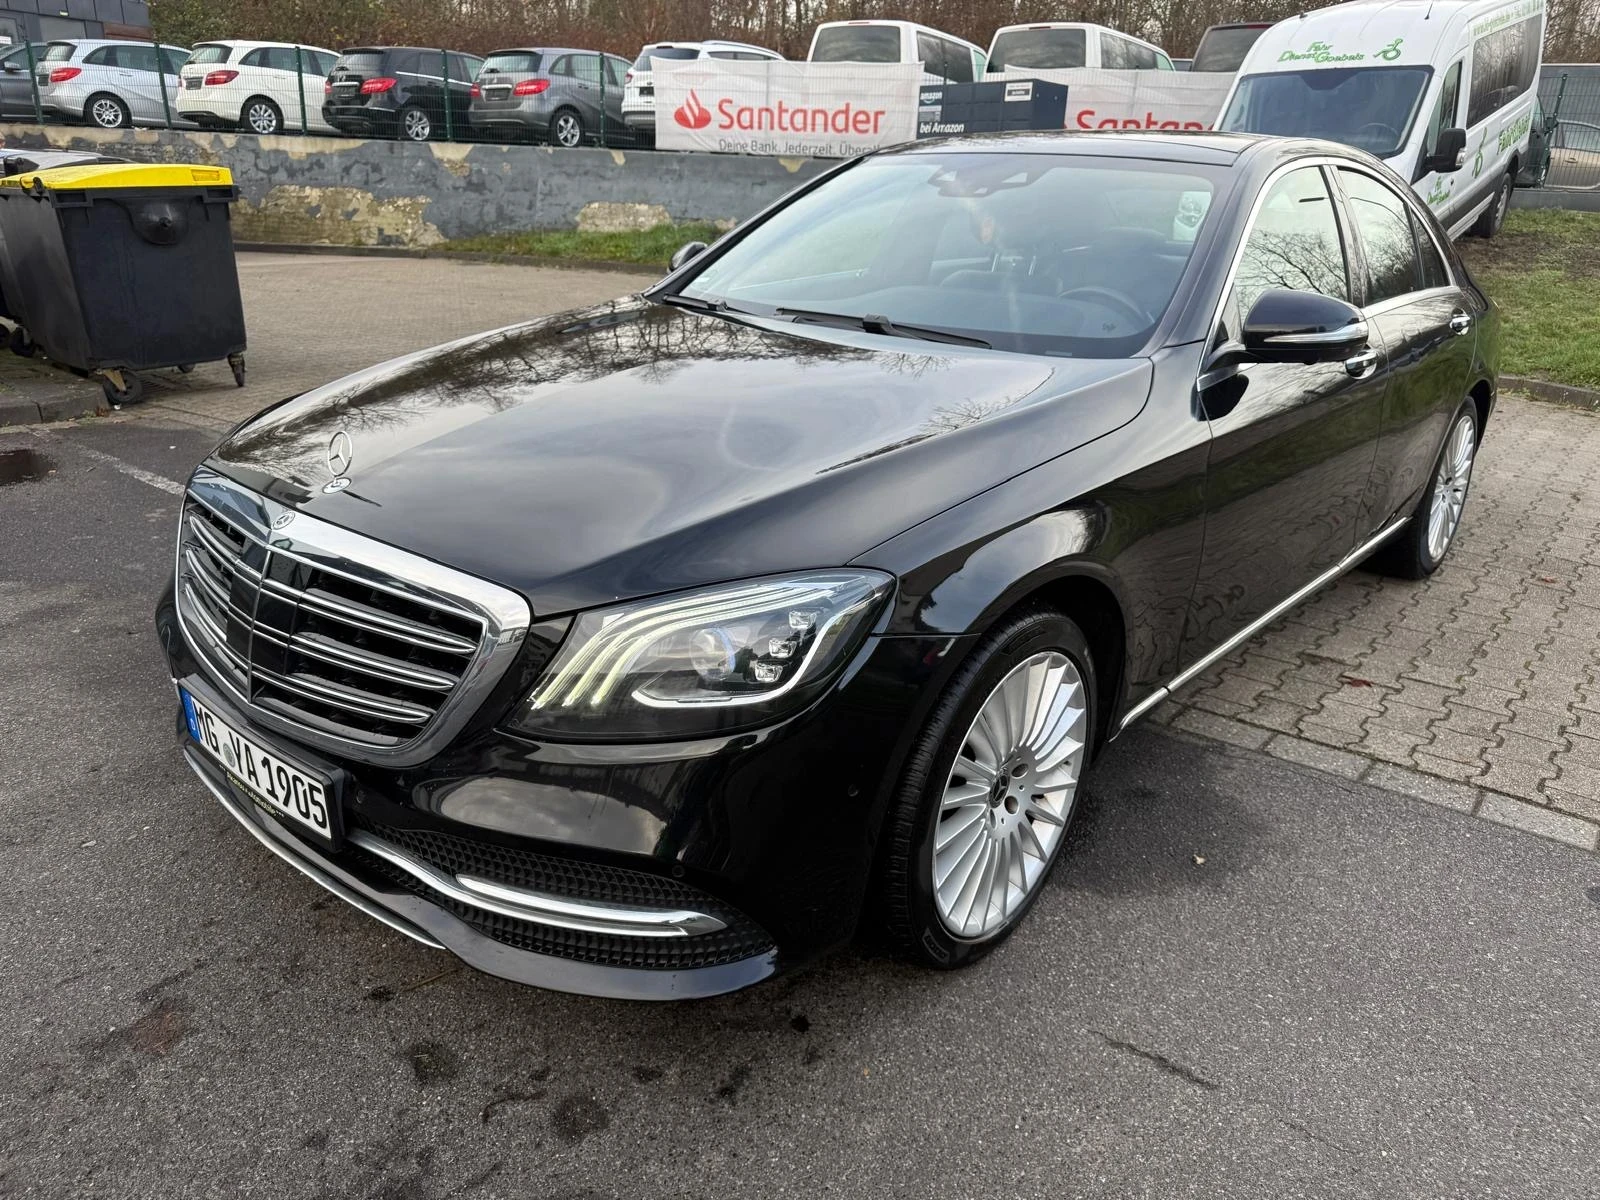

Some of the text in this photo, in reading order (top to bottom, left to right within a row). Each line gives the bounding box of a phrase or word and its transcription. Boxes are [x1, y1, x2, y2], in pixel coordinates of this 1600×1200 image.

[718, 98, 886, 134] Santander
[919, 122, 964, 133] bei Amazon
[719, 139, 748, 151] Deine
[751, 140, 781, 153] Bank.
[784, 142, 836, 155] Jederzeit.
[192, 700, 221, 756] MG
[228, 730, 261, 788] YA
[261, 756, 327, 829] 1905
